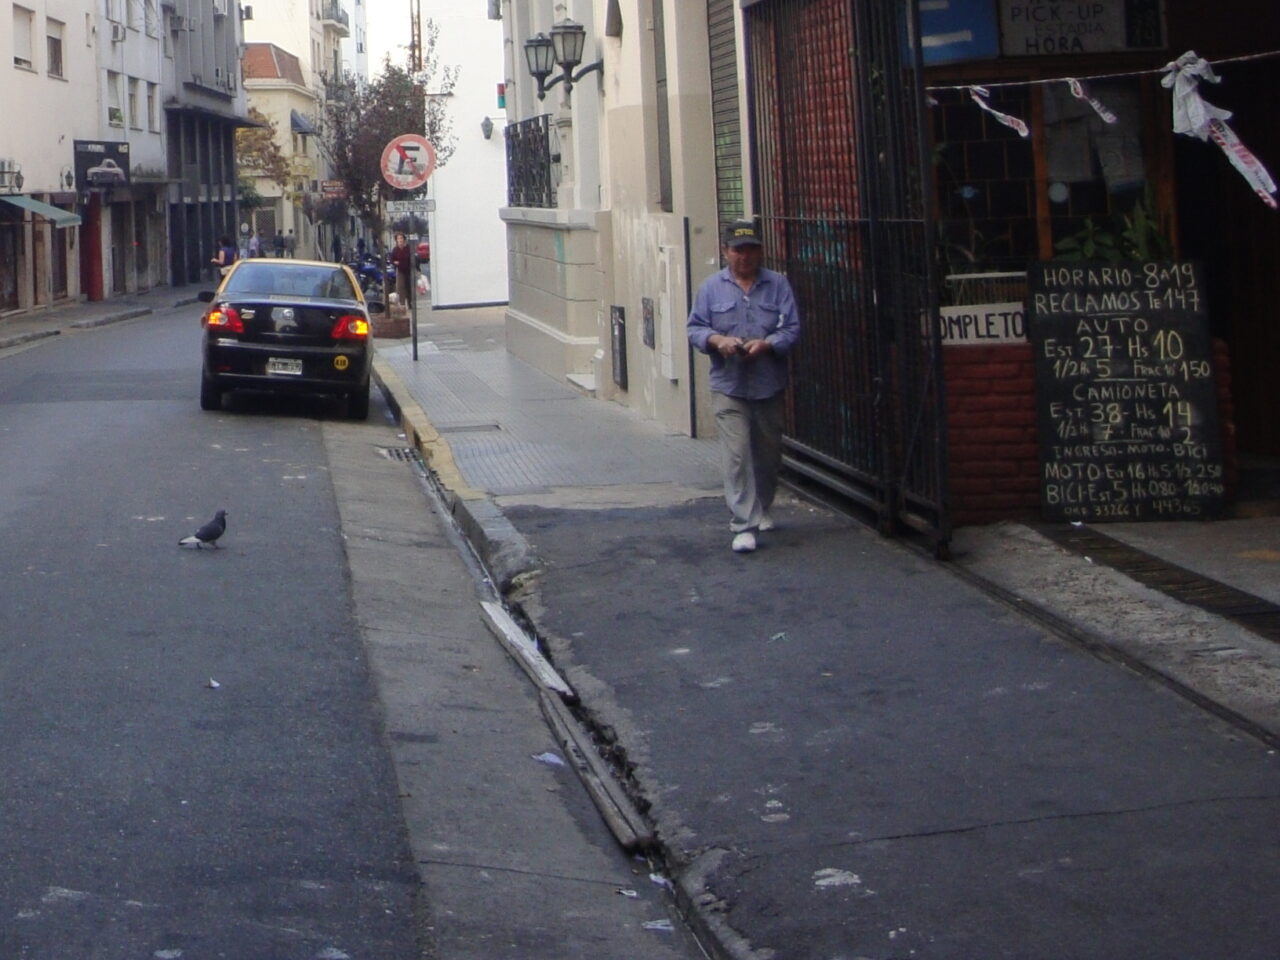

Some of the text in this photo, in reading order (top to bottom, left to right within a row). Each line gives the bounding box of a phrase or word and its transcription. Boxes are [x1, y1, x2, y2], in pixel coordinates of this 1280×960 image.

[1011, 3, 1104, 21] PICK-UP
[1025, 36, 1084, 54] HORA
[1035, 291, 1141, 314] RECLAMOS
[1163, 287, 1200, 312] 147
[1076, 317, 1149, 335] AUTO
[1153, 329, 1184, 360] 10
[1096, 358, 1111, 378] 5
[1072, 382, 1181, 401] CAMIONETA
[1162, 400, 1191, 429] 14
[1179, 426, 1195, 445] 2
